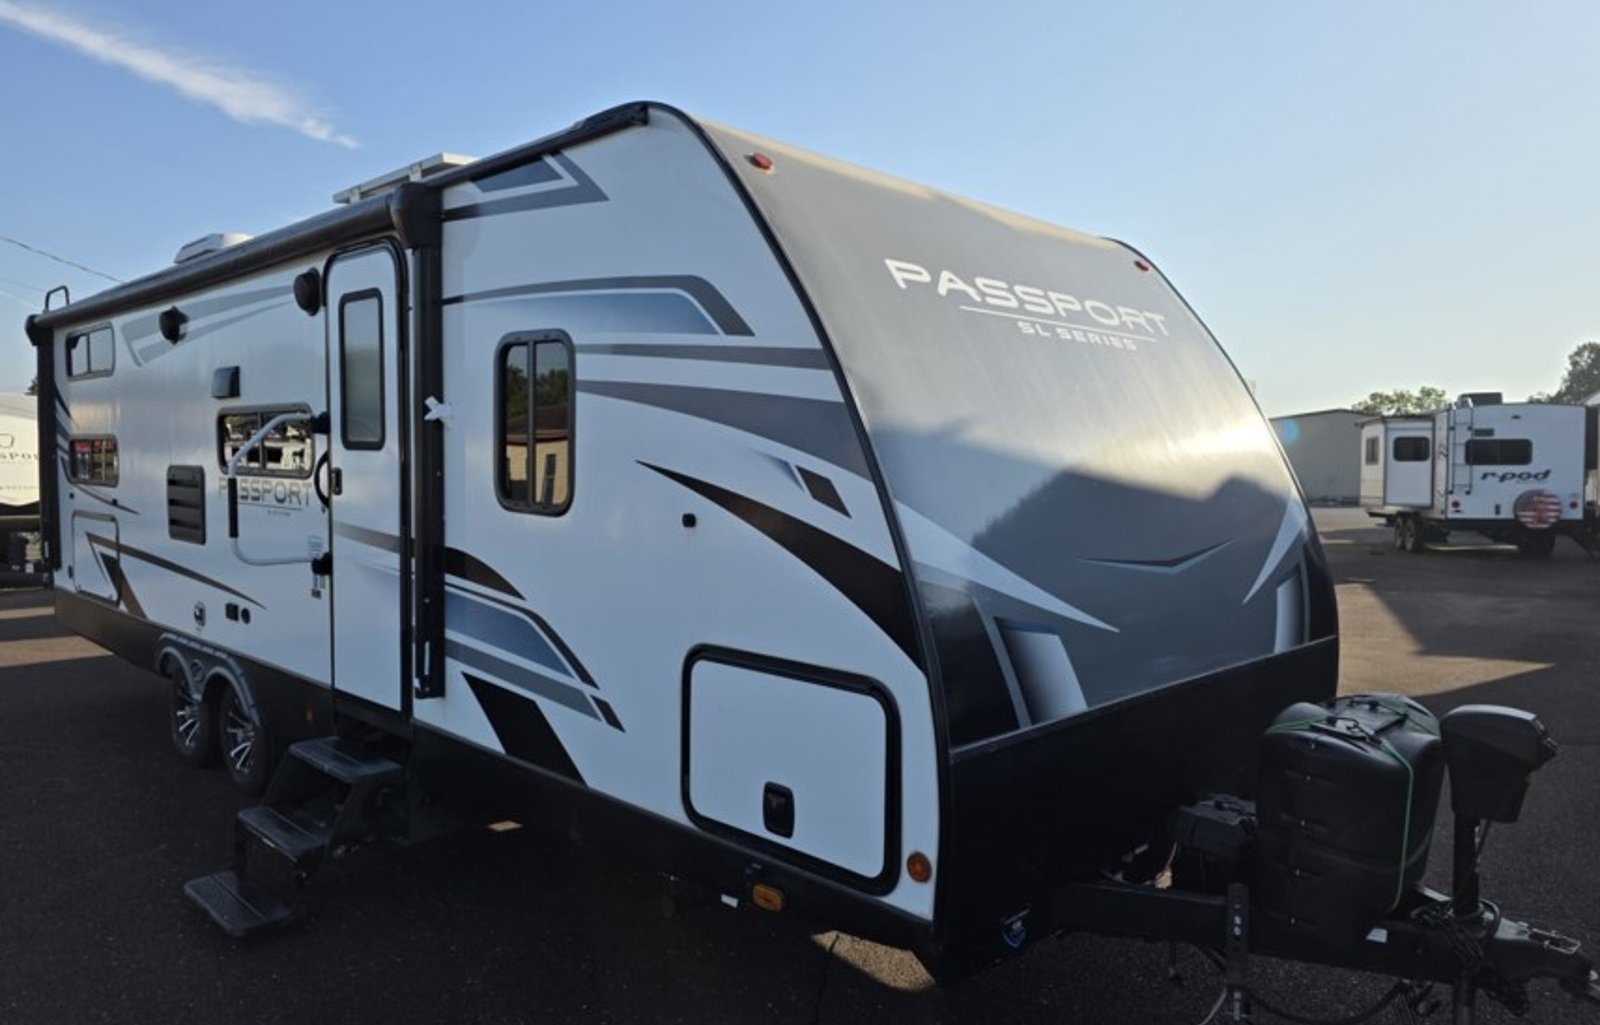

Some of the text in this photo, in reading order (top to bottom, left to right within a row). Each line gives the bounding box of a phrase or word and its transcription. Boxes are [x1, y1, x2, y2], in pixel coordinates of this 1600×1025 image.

[884, 258, 1169, 336] PASSPORT
[1017, 320, 1138, 351] SL SERIES
[218, 476, 312, 506] PSSPORT
